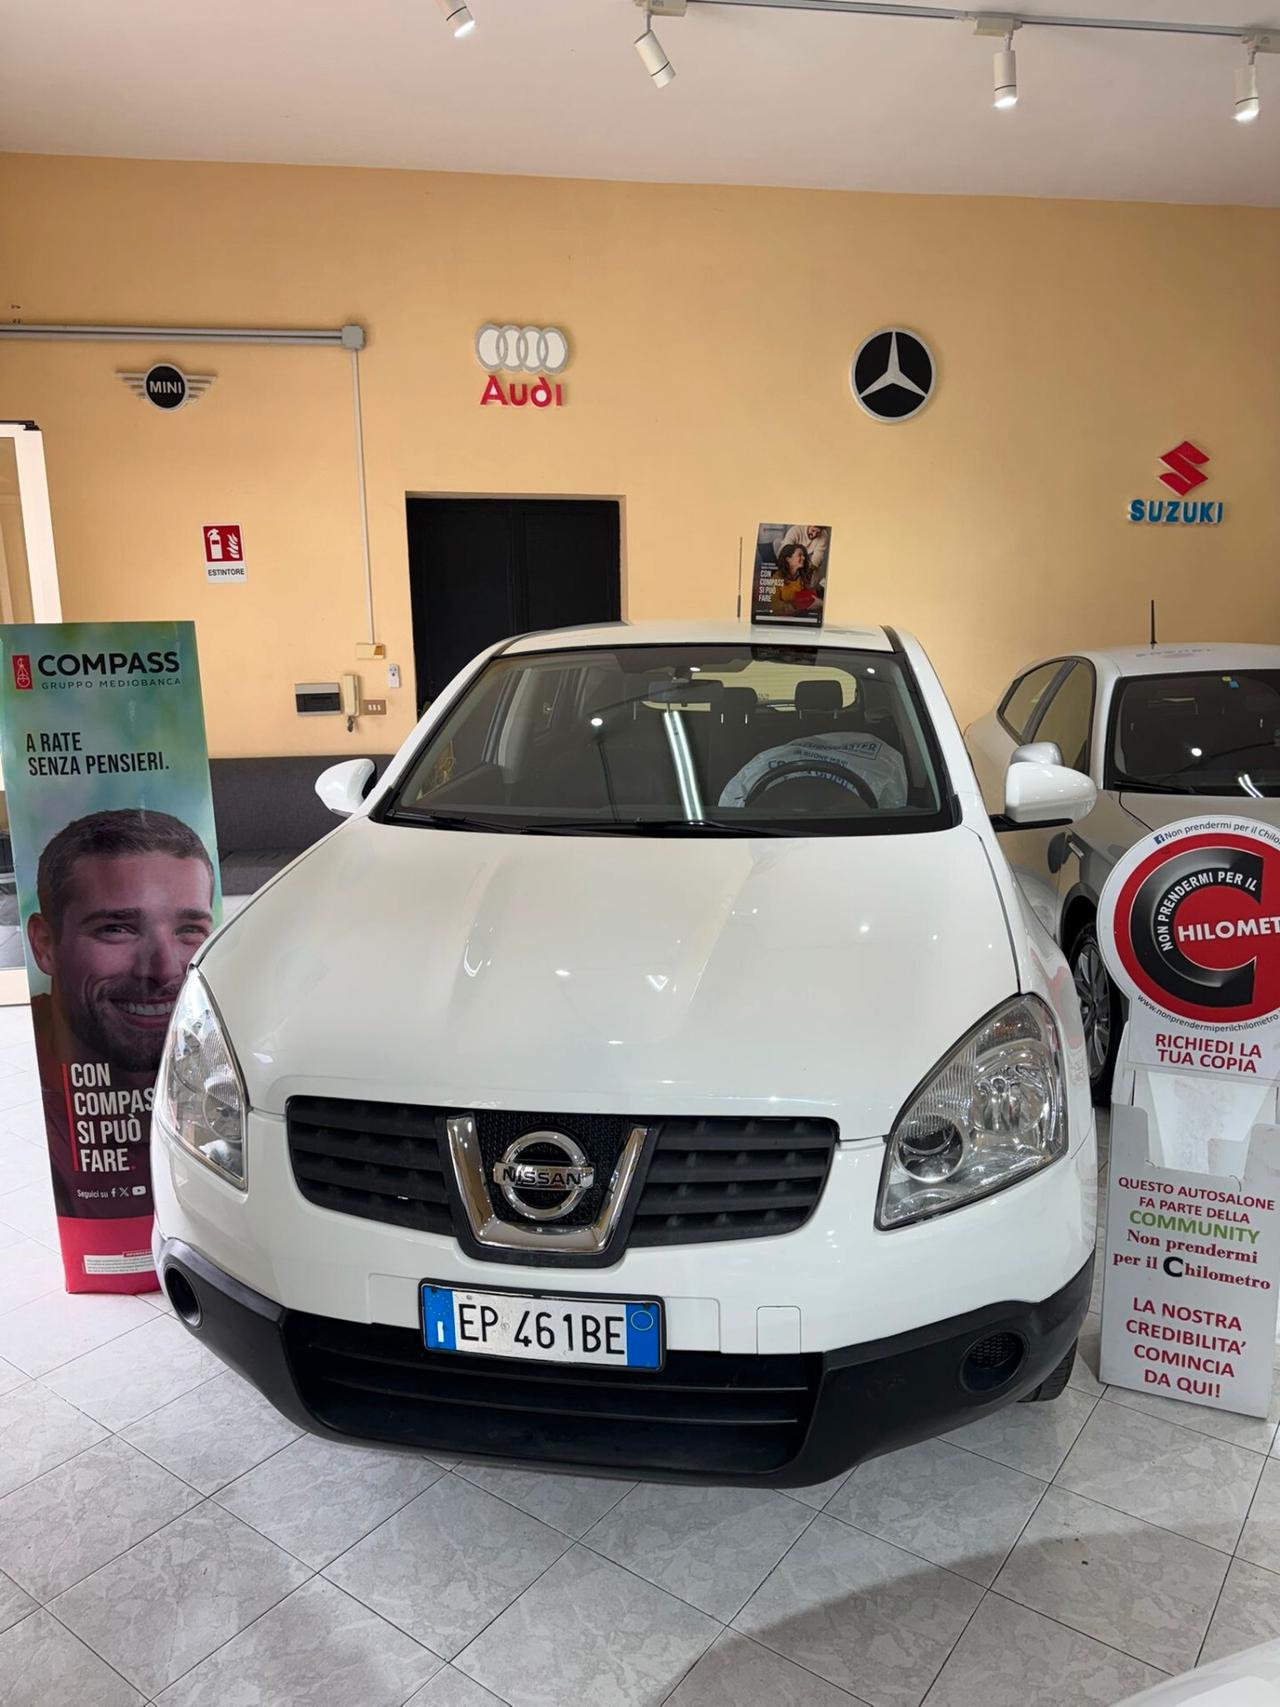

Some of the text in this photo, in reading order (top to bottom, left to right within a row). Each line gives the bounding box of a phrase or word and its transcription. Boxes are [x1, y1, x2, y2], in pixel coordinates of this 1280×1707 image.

[149, 379, 182, 395] MINI
[480, 375, 563, 407] Audi
[1128, 499, 1223, 523] SUZUKI
[208, 568, 245, 576] ESTINTORE
[38, 652, 180, 677] COMPASS
[42, 678, 181, 690] GRUPPO MEDIOBANCA
[26, 732, 82, 752] A RATE
[28, 751, 170, 777] SENZA PENSIERI.
[1164, 821, 1280, 846] Non prendermi per il Chilo
[1157, 871, 1258, 951] NON PRENDERMI PER IL
[1137, 995, 1280, 1034] www.nonprendermiperilchilometro
[1155, 1033, 1262, 1059] RICHIEDI LA
[70, 1063, 111, 1087] CON
[1157, 1049, 1257, 1074] TUA COPIA
[77, 1113, 142, 1144] SI PUÒ
[502, 1167, 582, 1186] NISSAN
[76, 1188, 100, 1200] Seguici
[1118, 1176, 1275, 1211] QUESTO AUTOSALONE
[1139, 1196, 1250, 1224] FA PARTE DELLA
[1129, 1210, 1260, 1245] COMMUNITY
[1127, 1229, 1258, 1264] Non prendermi
[1112, 1252, 1271, 1291] per il Chilometro
[1132, 1297, 1242, 1332] LA NOSTRA
[458, 1303, 625, 1355] EP 461BE
[1126, 1319, 1247, 1356] CREDIBILITA'
[1133, 1344, 1235, 1378] COMINCIA
[1144, 1368, 1221, 1398] DA QUI!
